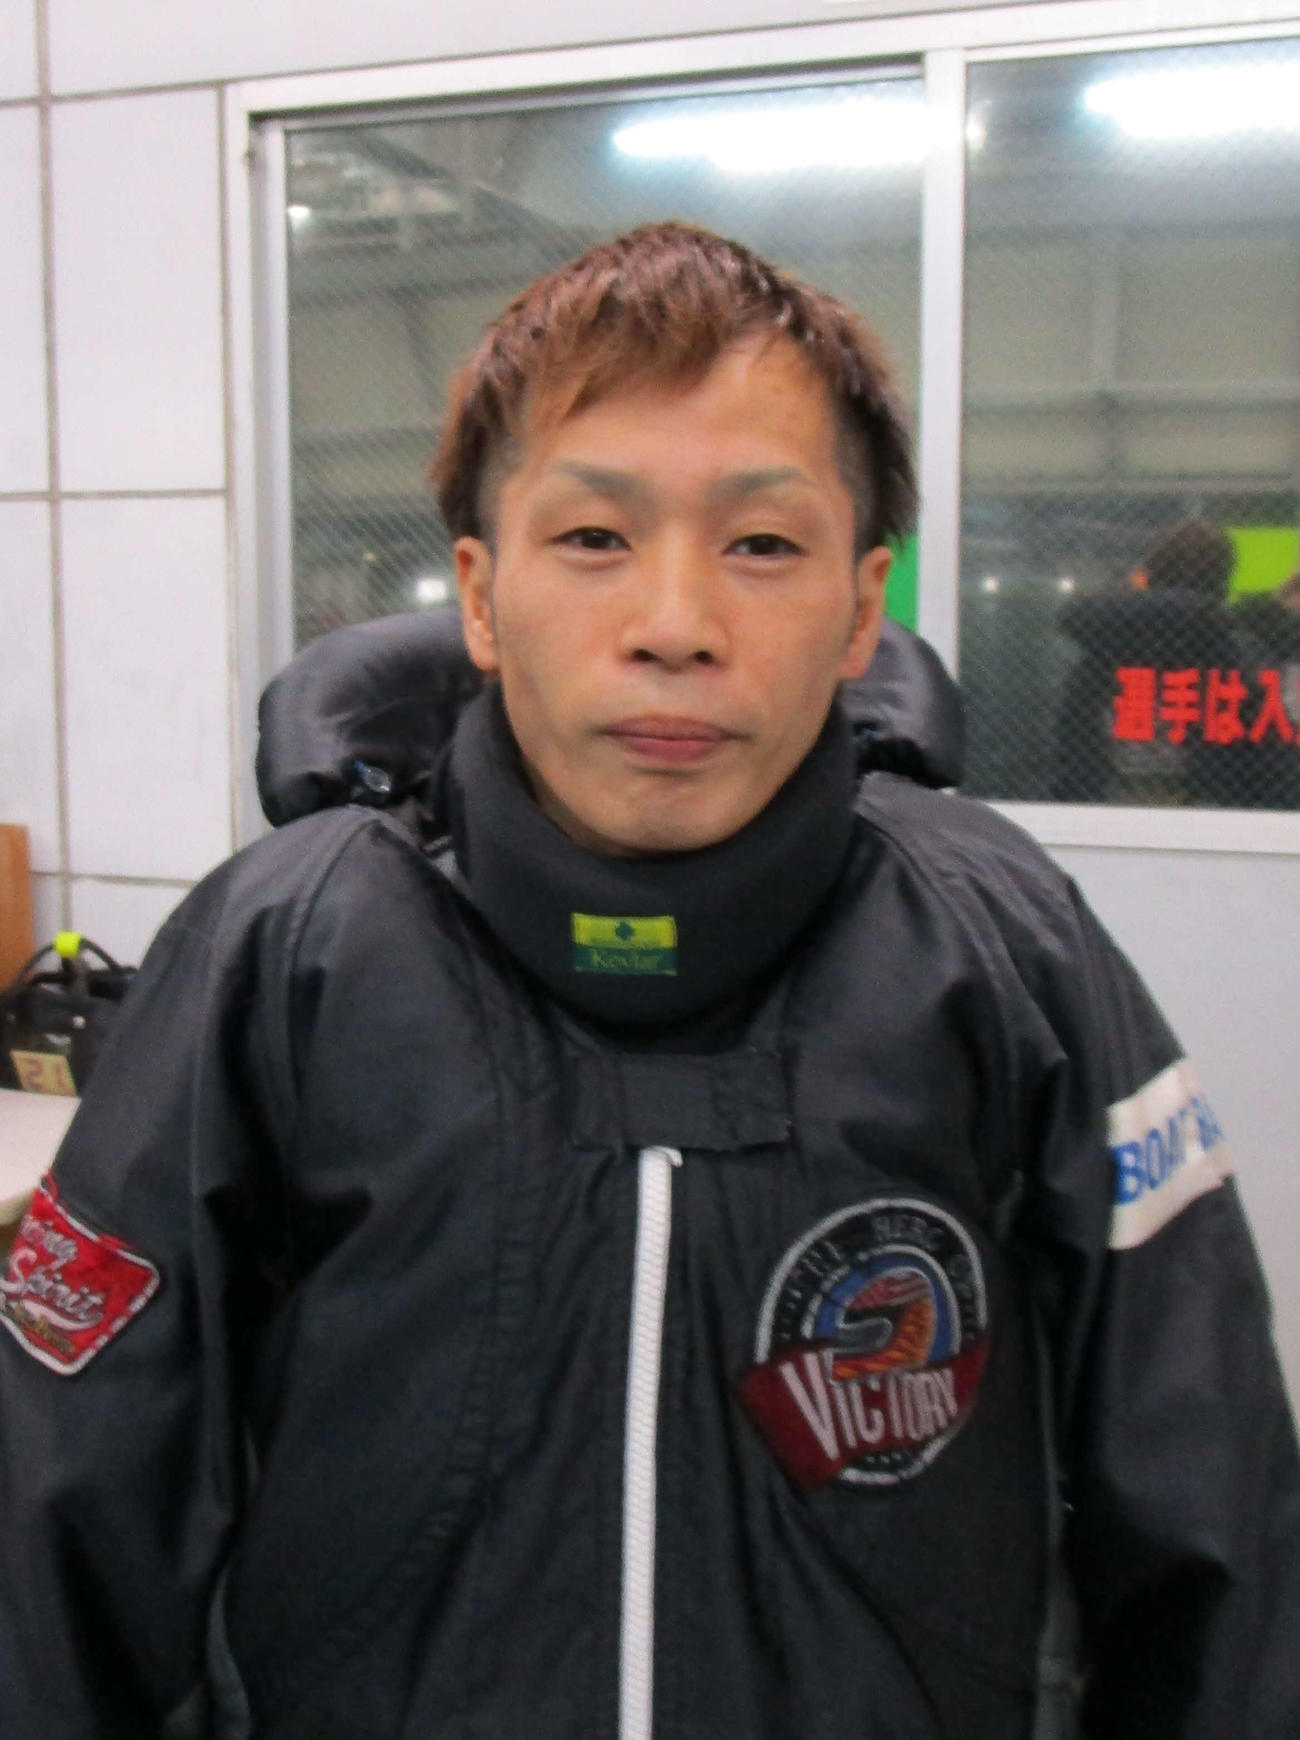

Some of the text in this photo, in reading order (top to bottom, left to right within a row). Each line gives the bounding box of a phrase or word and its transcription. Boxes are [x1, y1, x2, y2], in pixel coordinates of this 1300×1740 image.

[1113, 667, 1300, 745] 選手は入
[779, 1350, 958, 1462] VICTORY
